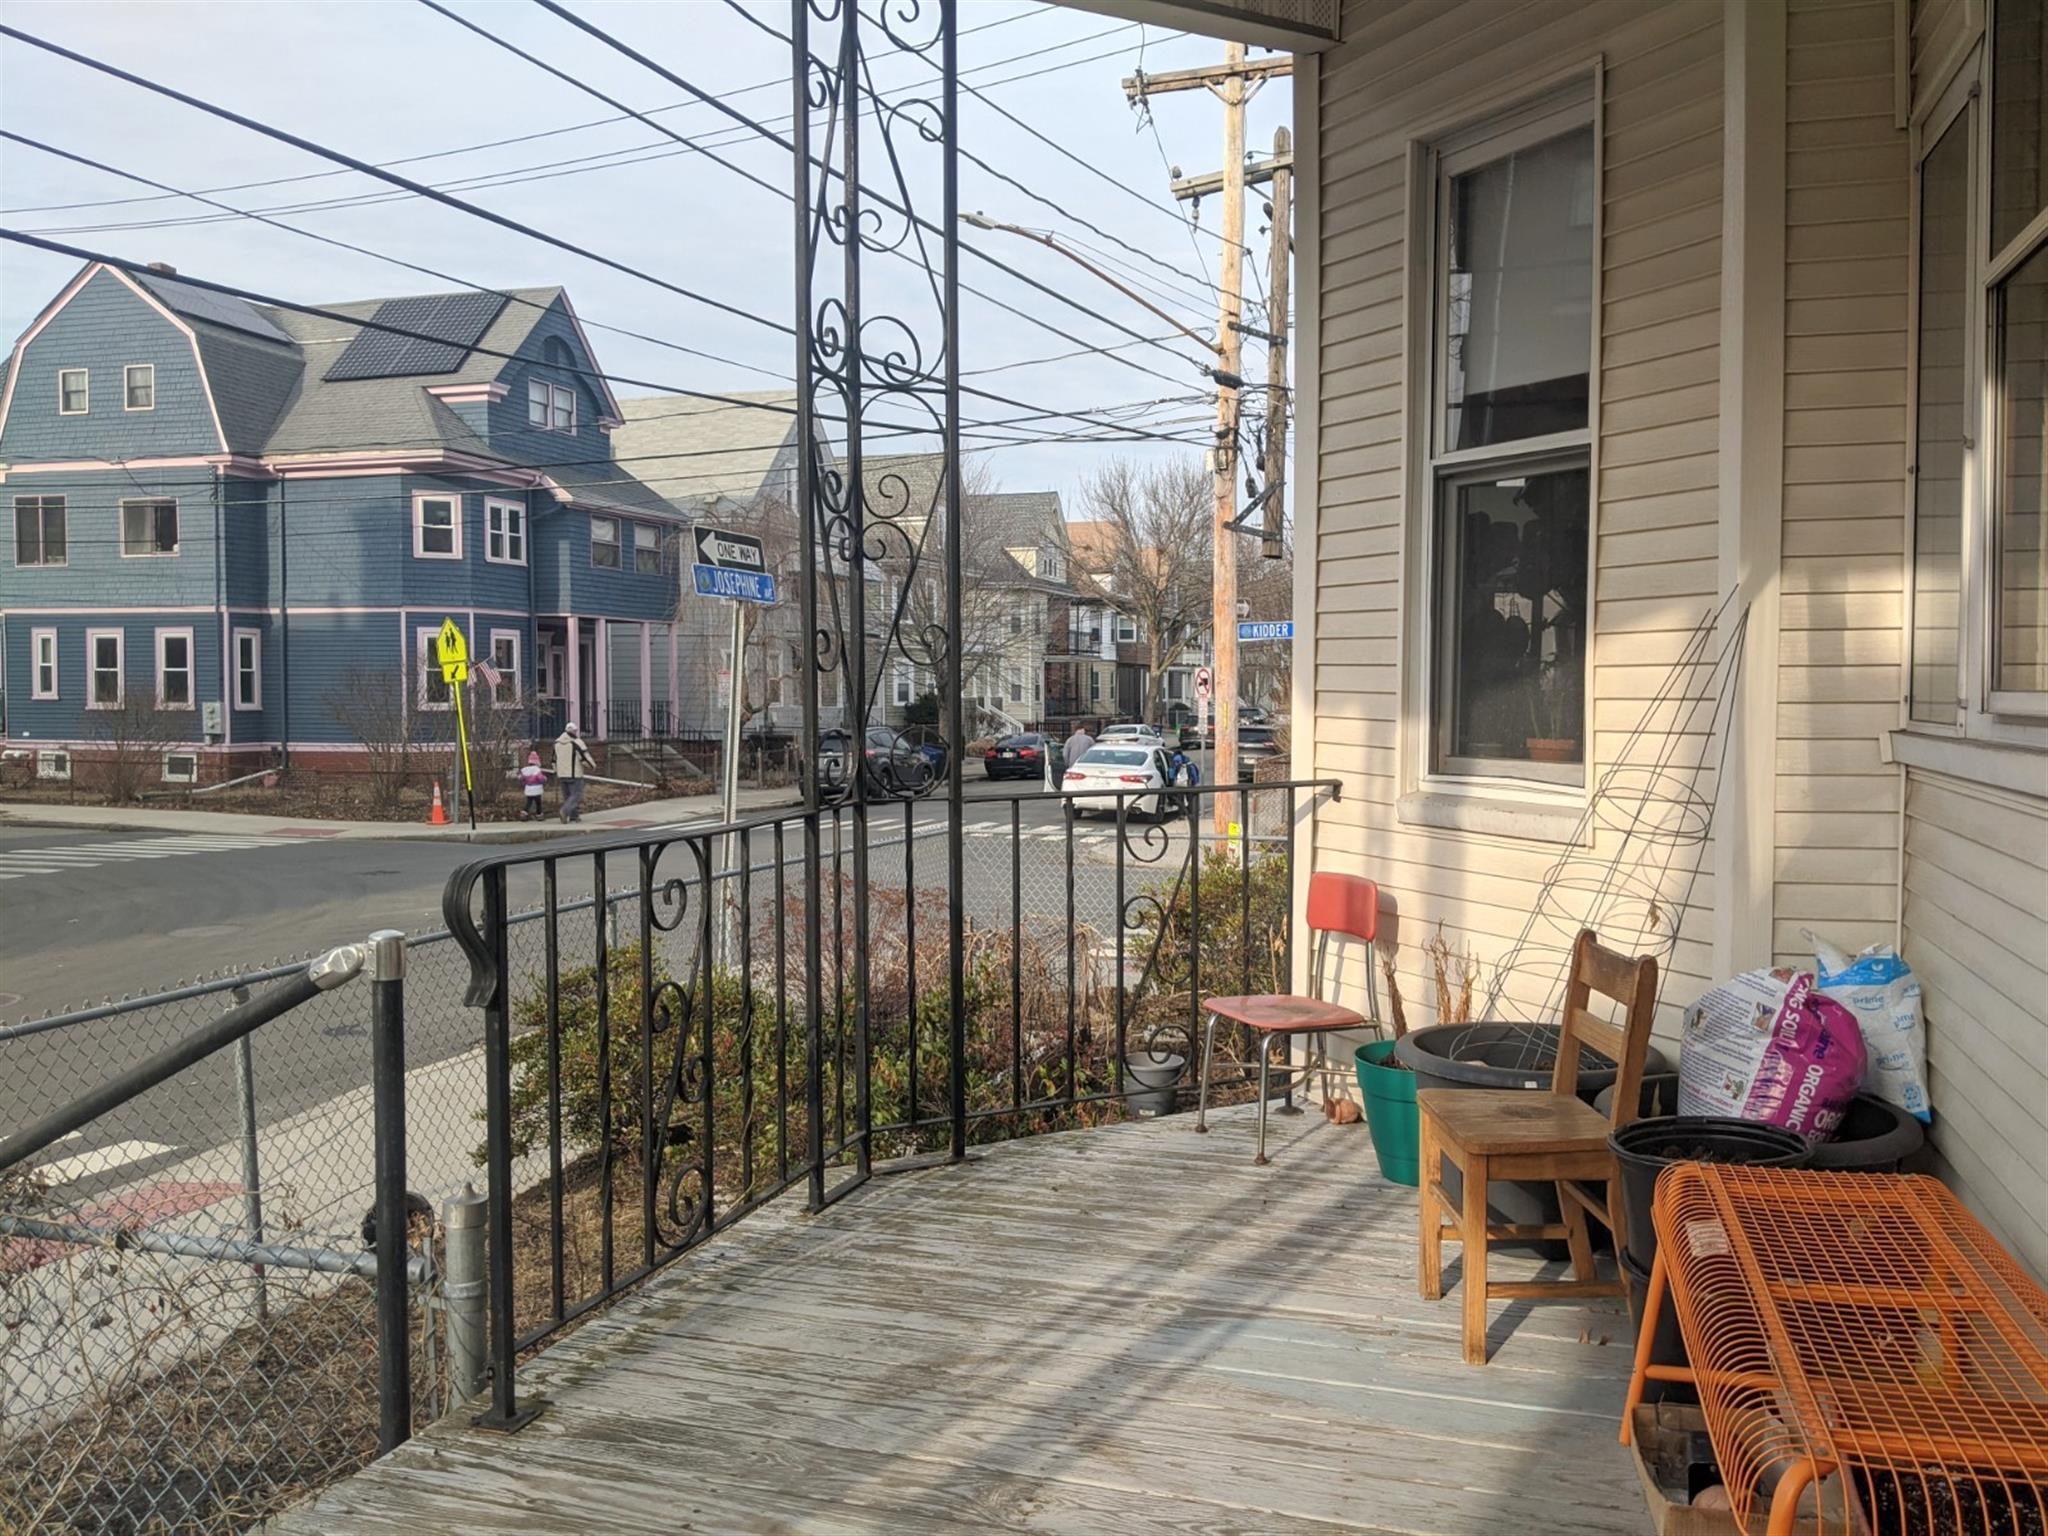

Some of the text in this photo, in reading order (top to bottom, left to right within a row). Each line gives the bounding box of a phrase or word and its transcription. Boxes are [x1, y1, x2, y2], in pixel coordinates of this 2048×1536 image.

[717, 541, 758, 562] ONE WAY
[713, 570, 762, 598] JOSEPHINE
[1252, 624, 1289, 637] KIDDER
[1785, 1064, 1824, 1131] ORGANIC
